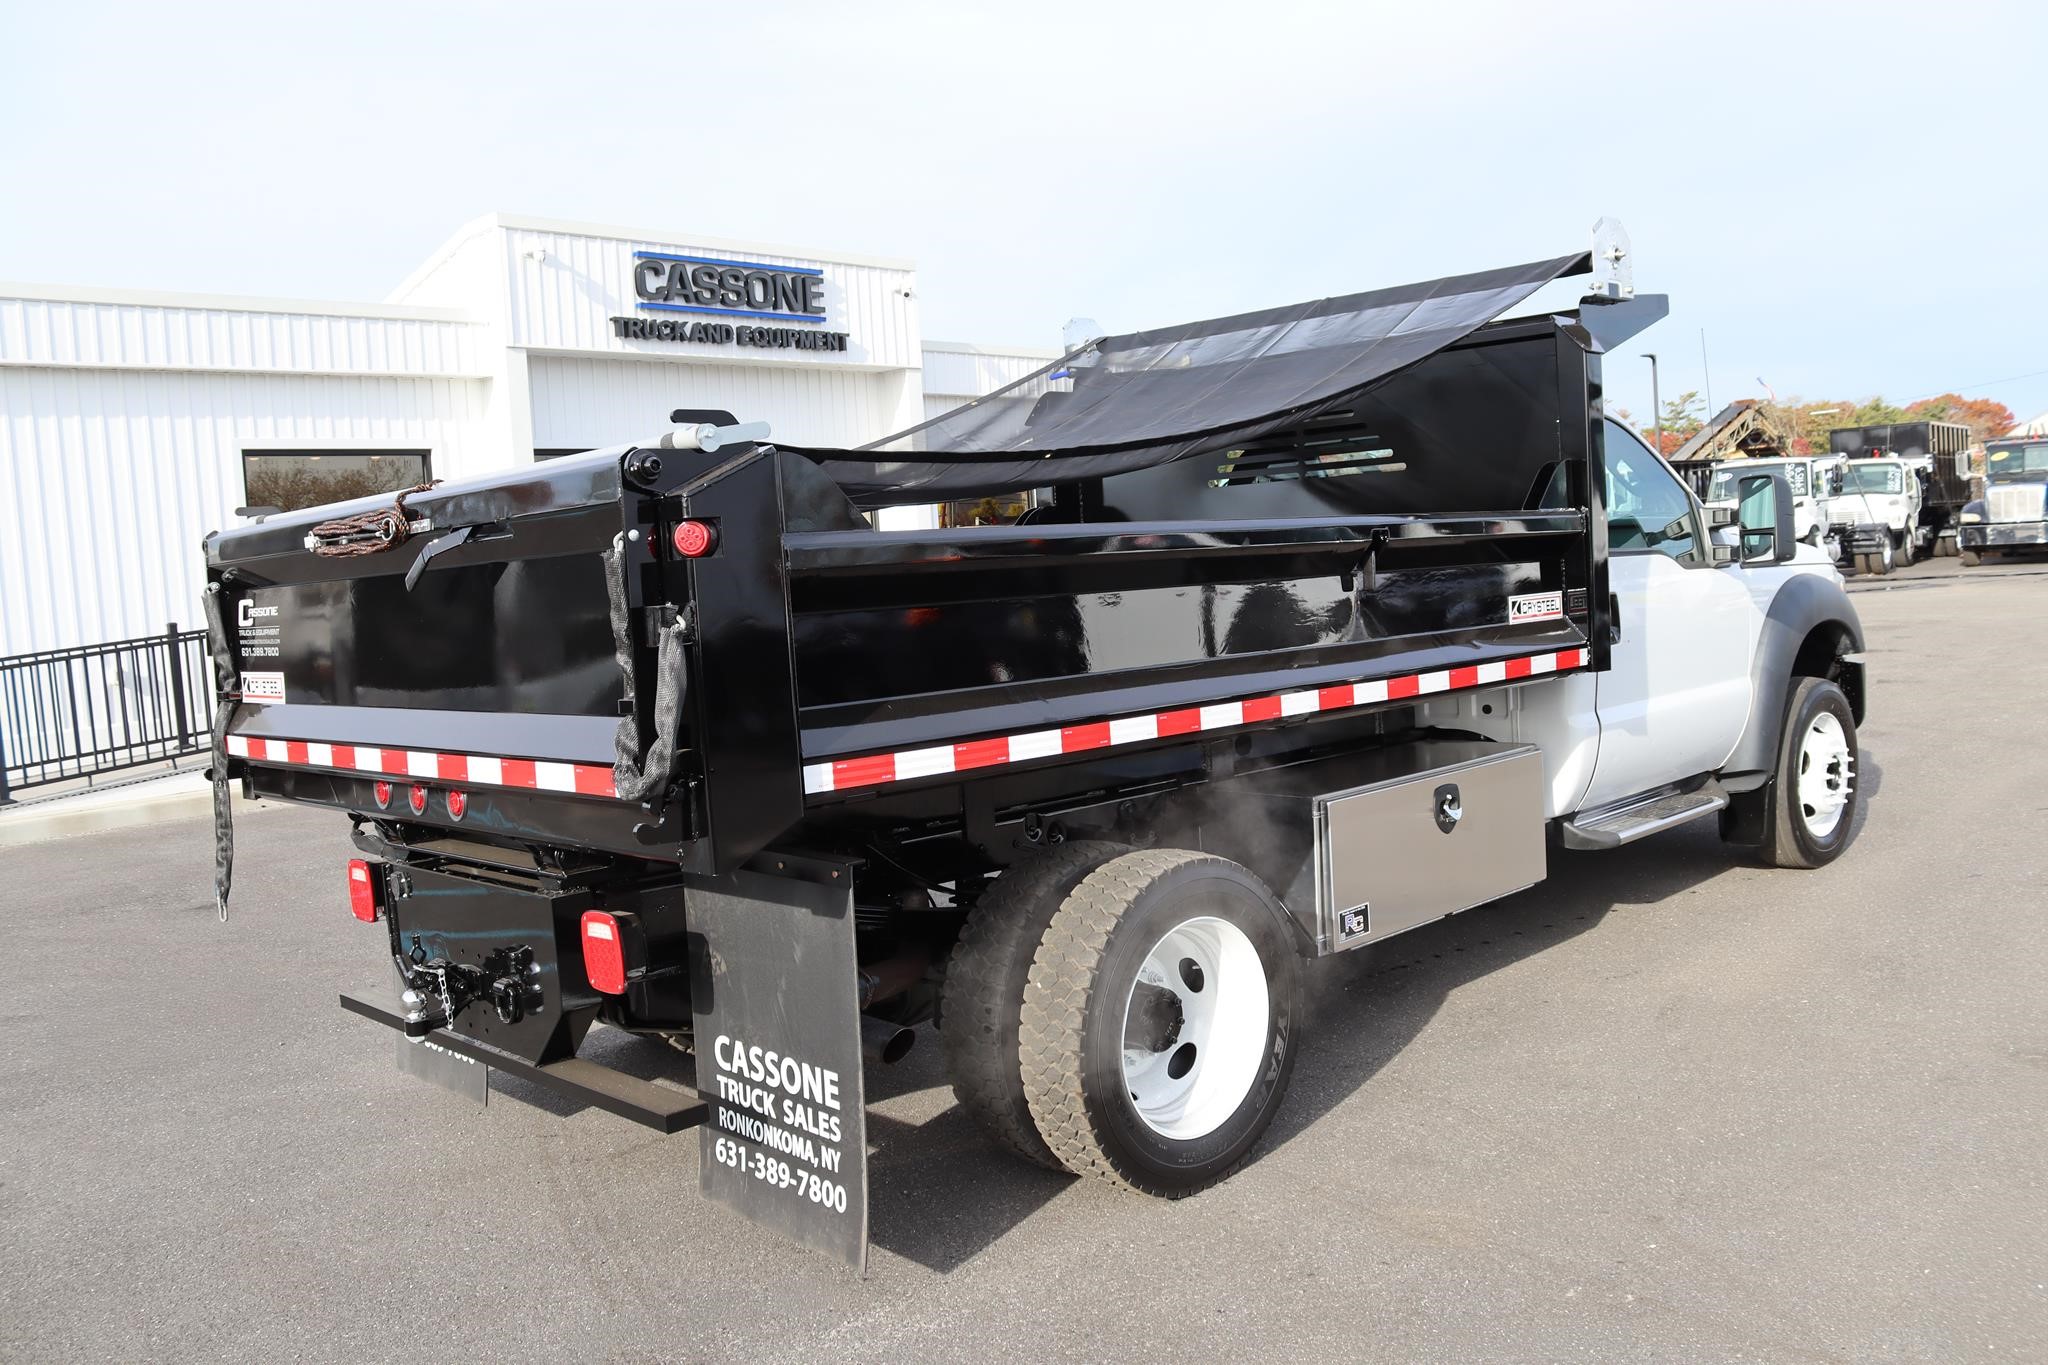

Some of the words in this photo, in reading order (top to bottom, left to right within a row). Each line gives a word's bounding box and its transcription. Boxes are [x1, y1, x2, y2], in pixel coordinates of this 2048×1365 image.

[635, 260, 826, 314] CASSONE
[610, 316, 688, 342] TRUCK
[688, 322, 735, 345] AND
[736, 325, 850, 352] EQUIPMENT
[714, 1034, 841, 1111] CASSONE
[716, 1074, 777, 1119] TRUCK
[782, 1099, 841, 1143] SALES
[718, 1106, 820, 1168] RONKONKOMA,
[821, 1145, 841, 1173] NY
[715, 1138, 847, 1214] 631-389-7800
